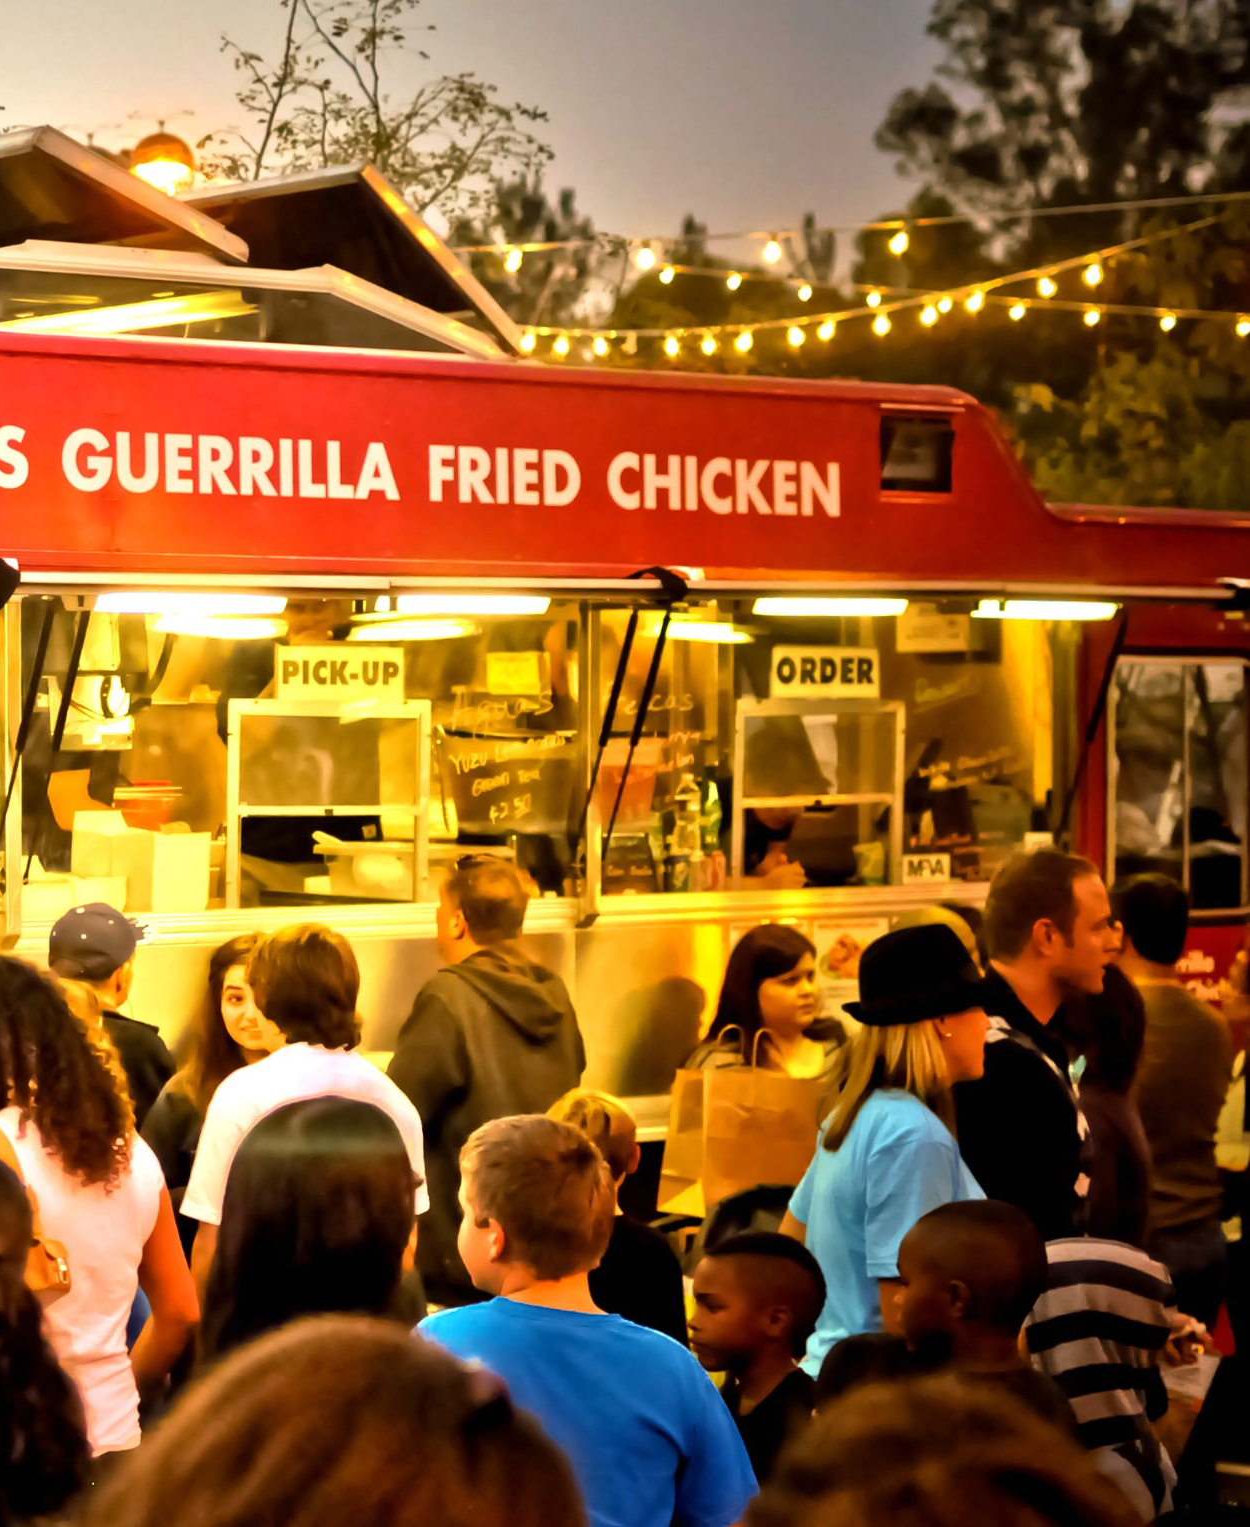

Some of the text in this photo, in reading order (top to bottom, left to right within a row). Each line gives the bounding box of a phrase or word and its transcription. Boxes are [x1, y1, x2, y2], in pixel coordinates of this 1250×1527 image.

[61, 426, 401, 502] GUERRILLA
[428, 443, 582, 508] FRIED
[606, 450, 841, 518] CHICKEN
[282, 659, 400, 686] PICK-UP
[775, 656, 874, 685] ORDER
